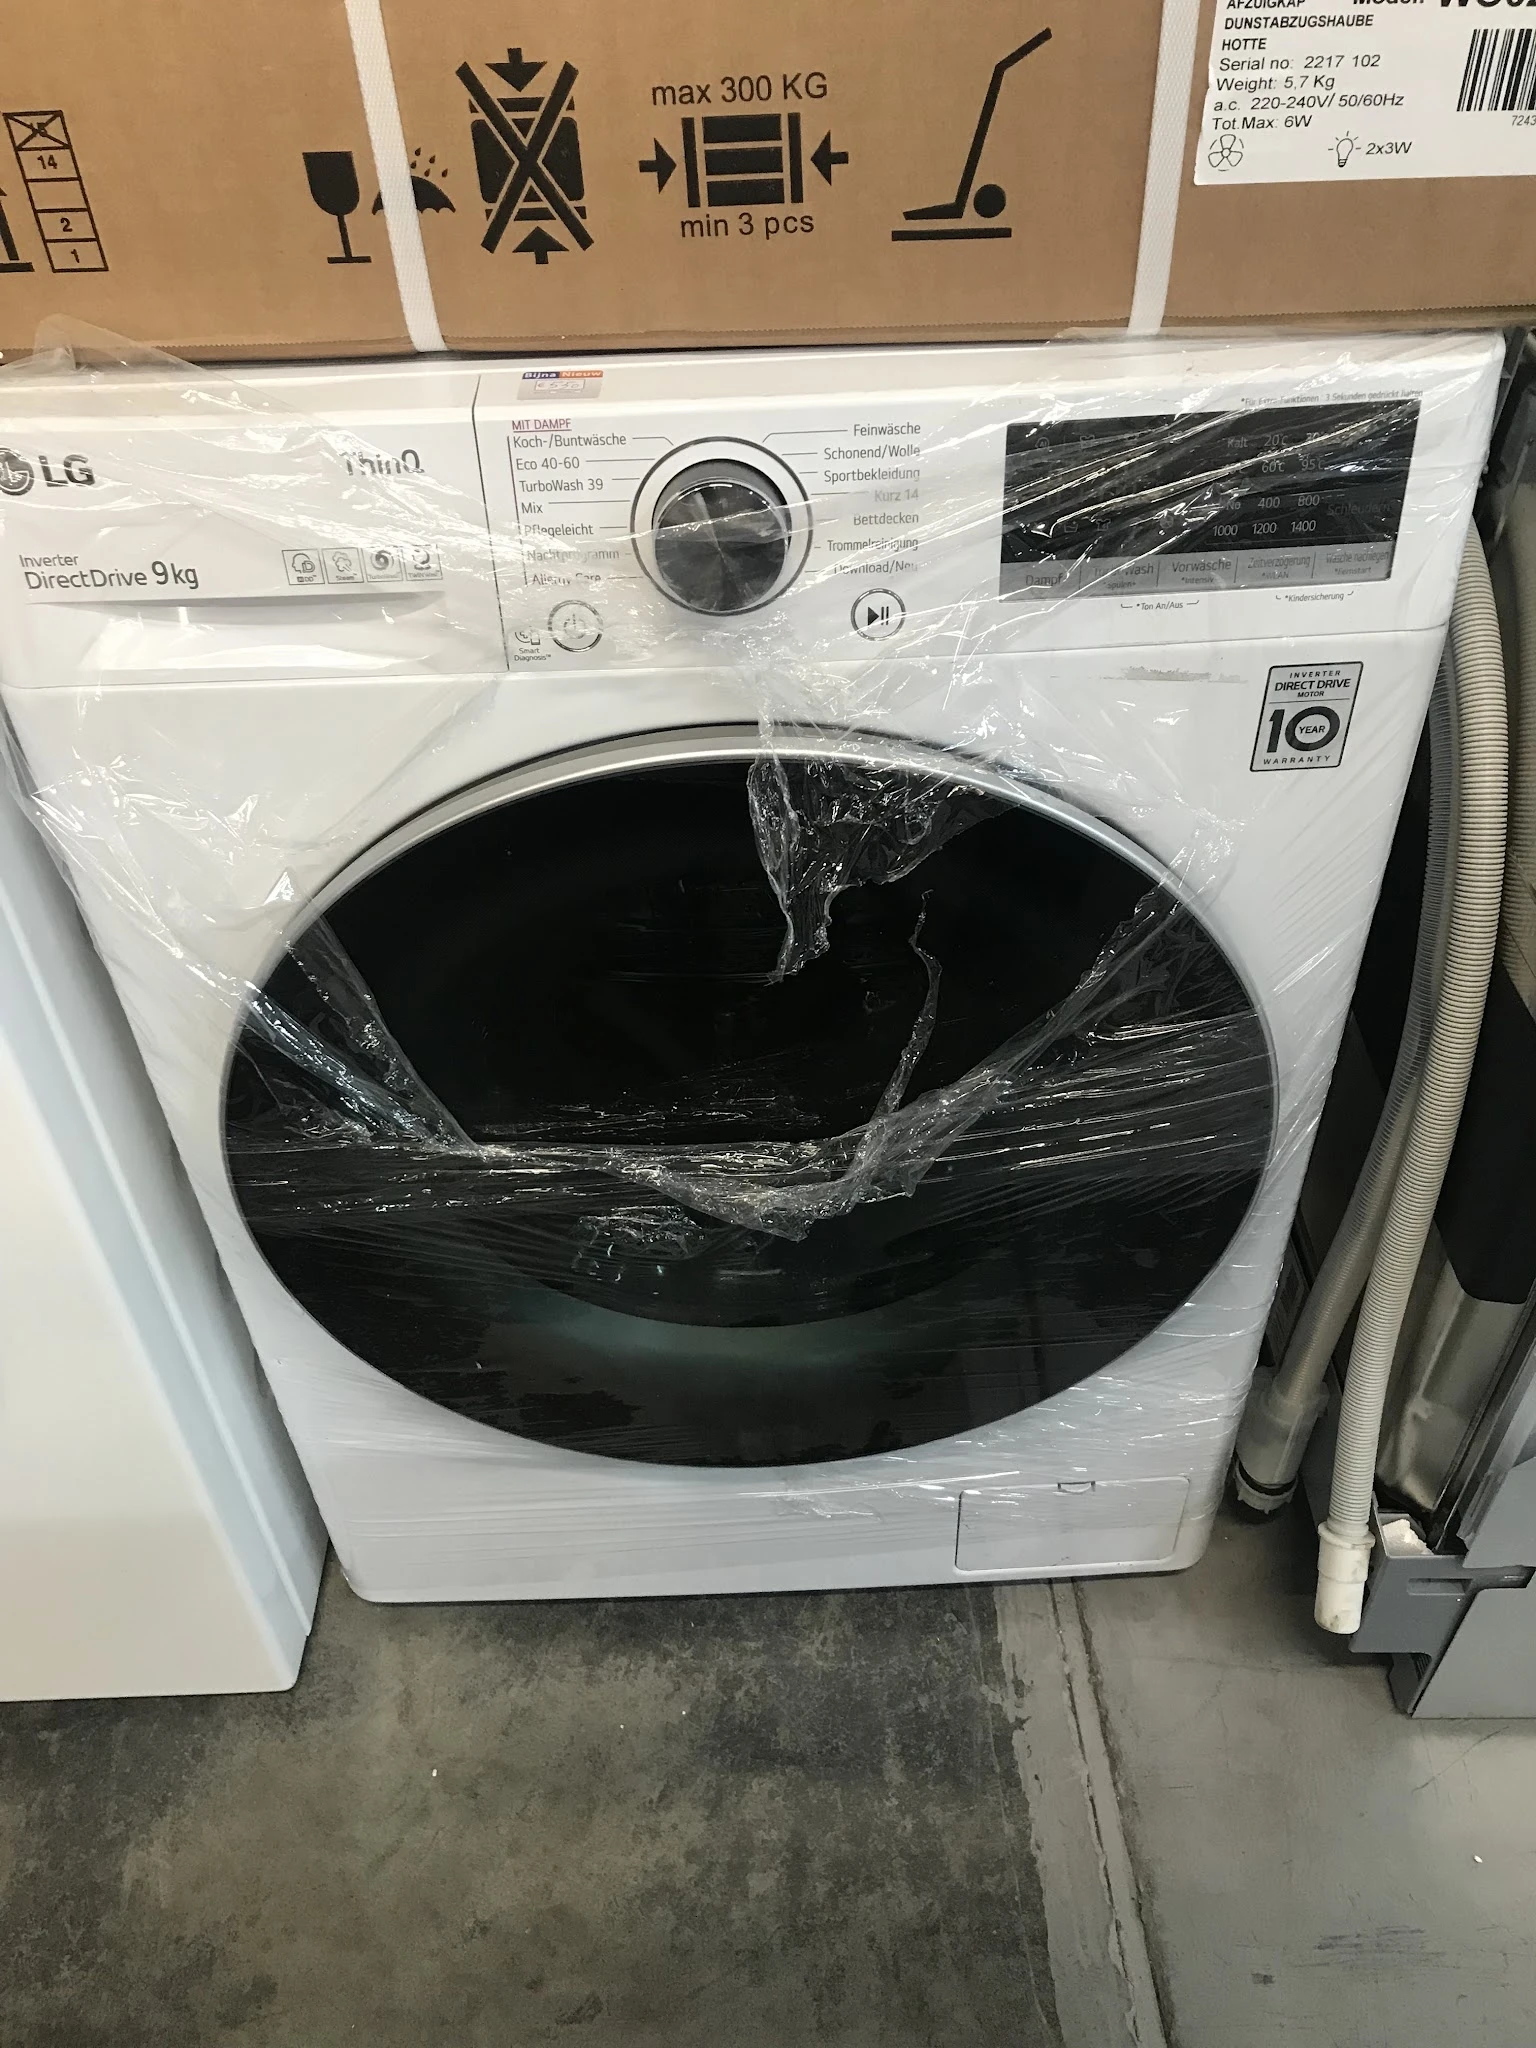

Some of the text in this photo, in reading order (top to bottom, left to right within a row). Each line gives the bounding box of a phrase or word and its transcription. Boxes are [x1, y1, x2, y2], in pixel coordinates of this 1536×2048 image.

[1224, 14, 1374, 30] DUNSTABZUGSHAUBE
[1222, 38, 1267, 51] HOTTE
[1219, 54, 1381, 72] Serial no: 2217 102
[651, 72, 828, 106] max 300 KG
[1216, 75, 1336, 93] Weight: 5,7 Kg
[1214, 93, 1404, 111] a.c. 220-240V/ 50/60Hz
[1284, 115, 1312, 129] 6W
[1366, 141, 1412, 155] 2x3W
[37, 154, 58, 170] 14
[60, 217, 73, 233] 2
[680, 212, 815, 240] min 3 pcs
[70, 249, 80, 264] 1
[524, 372, 557, 380] Bijna
[512, 418, 572, 430] MIT DAMPF
[853, 422, 921, 437] Feinwäsche
[513, 433, 627, 448] Koch-/Buntwäsche
[824, 444, 921, 460] Schonend/Wolle
[38, 454, 96, 487] LG
[516, 456, 580, 471] Eco 40-60
[824, 468, 921, 485] Sportbekleidung
[519, 478, 604, 492] TurboWash 39
[874, 489, 919, 503] Kurz 14
[1258, 496, 1281, 509] 400
[1297, 494, 1320, 507] 800
[521, 502, 543, 514] Mix
[853, 512, 919, 526] Bettdecken
[524, 524, 594, 538] Pflegeleicht
[1212, 520, 1317, 537] 1000 1200 1400
[827, 538, 919, 552] Trommelreinigung
[19, 554, 79, 568] Inverter
[24, 568, 148, 590] DirectDrive
[1025, 573, 1064, 586] Dampf
[1289, 670, 1341, 679] INVERTER
[1274, 678, 1352, 692] DIRECT DRIVE
[1266, 706, 1341, 753] 10
[1299, 725, 1326, 735] YEAR
[1263, 755, 1331, 766] WARRANTY
